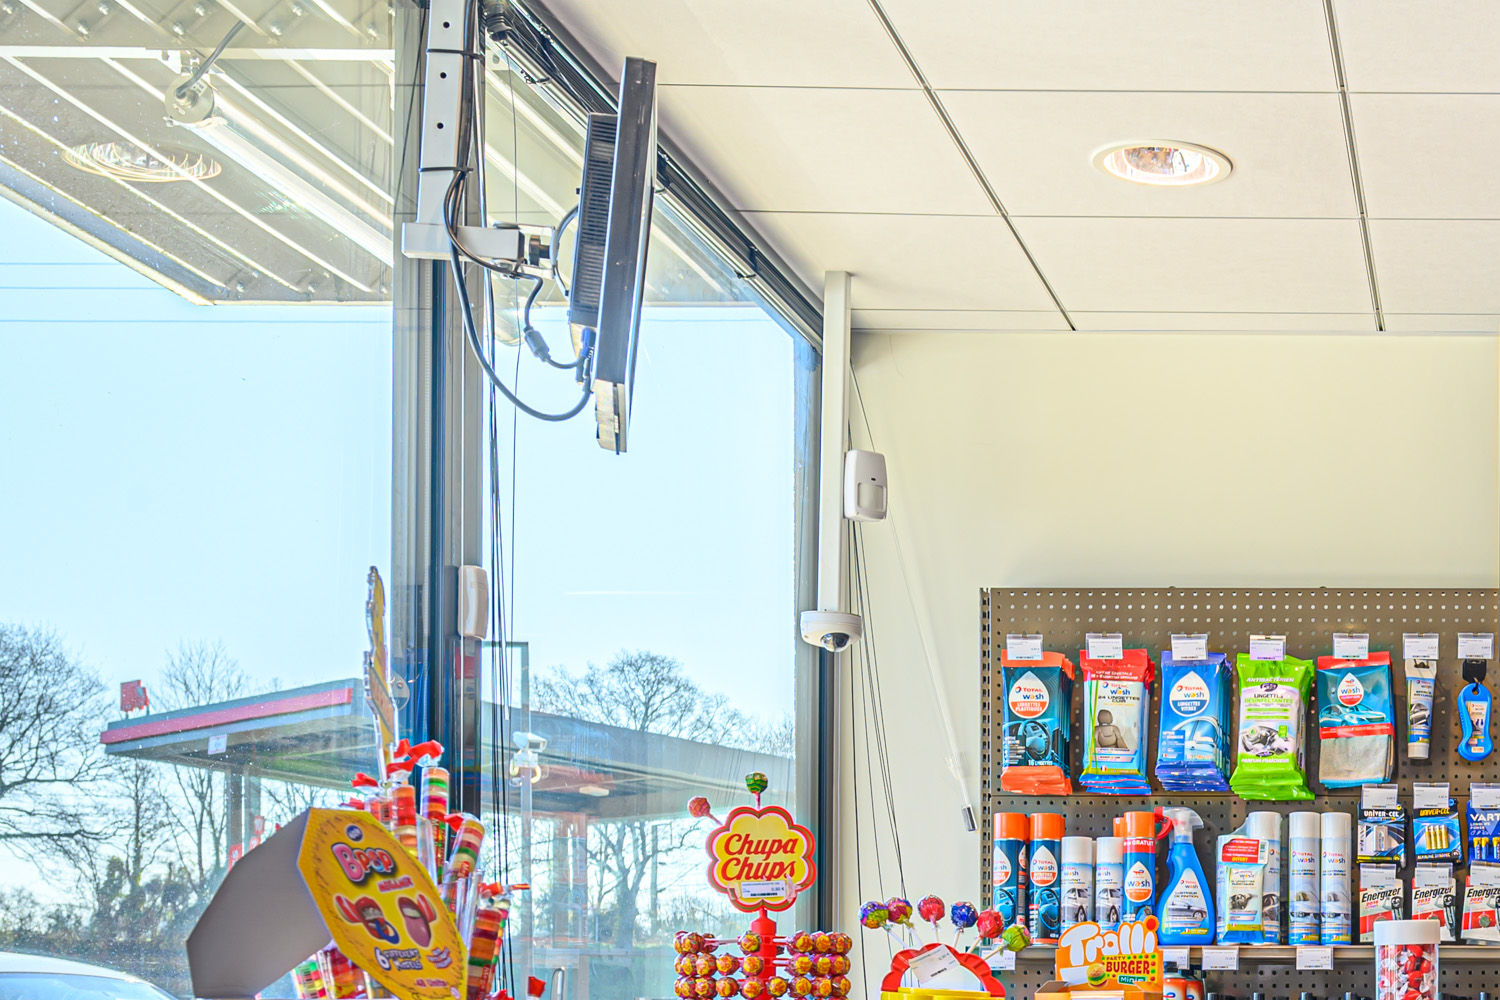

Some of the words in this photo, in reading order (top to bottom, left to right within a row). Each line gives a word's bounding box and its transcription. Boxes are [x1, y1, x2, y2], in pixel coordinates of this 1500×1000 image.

[1023, 692, 1044, 700] wash
[1341, 686, 1361, 694] wash
[724, 834, 798, 861] Chupa
[721, 858, 796, 881] Chups
[1127, 879, 1150, 888] wash
[1362, 888, 1401, 902] Energizer
[1061, 916, 1158, 966] Trolli
[1106, 960, 1150, 974] BURGER
